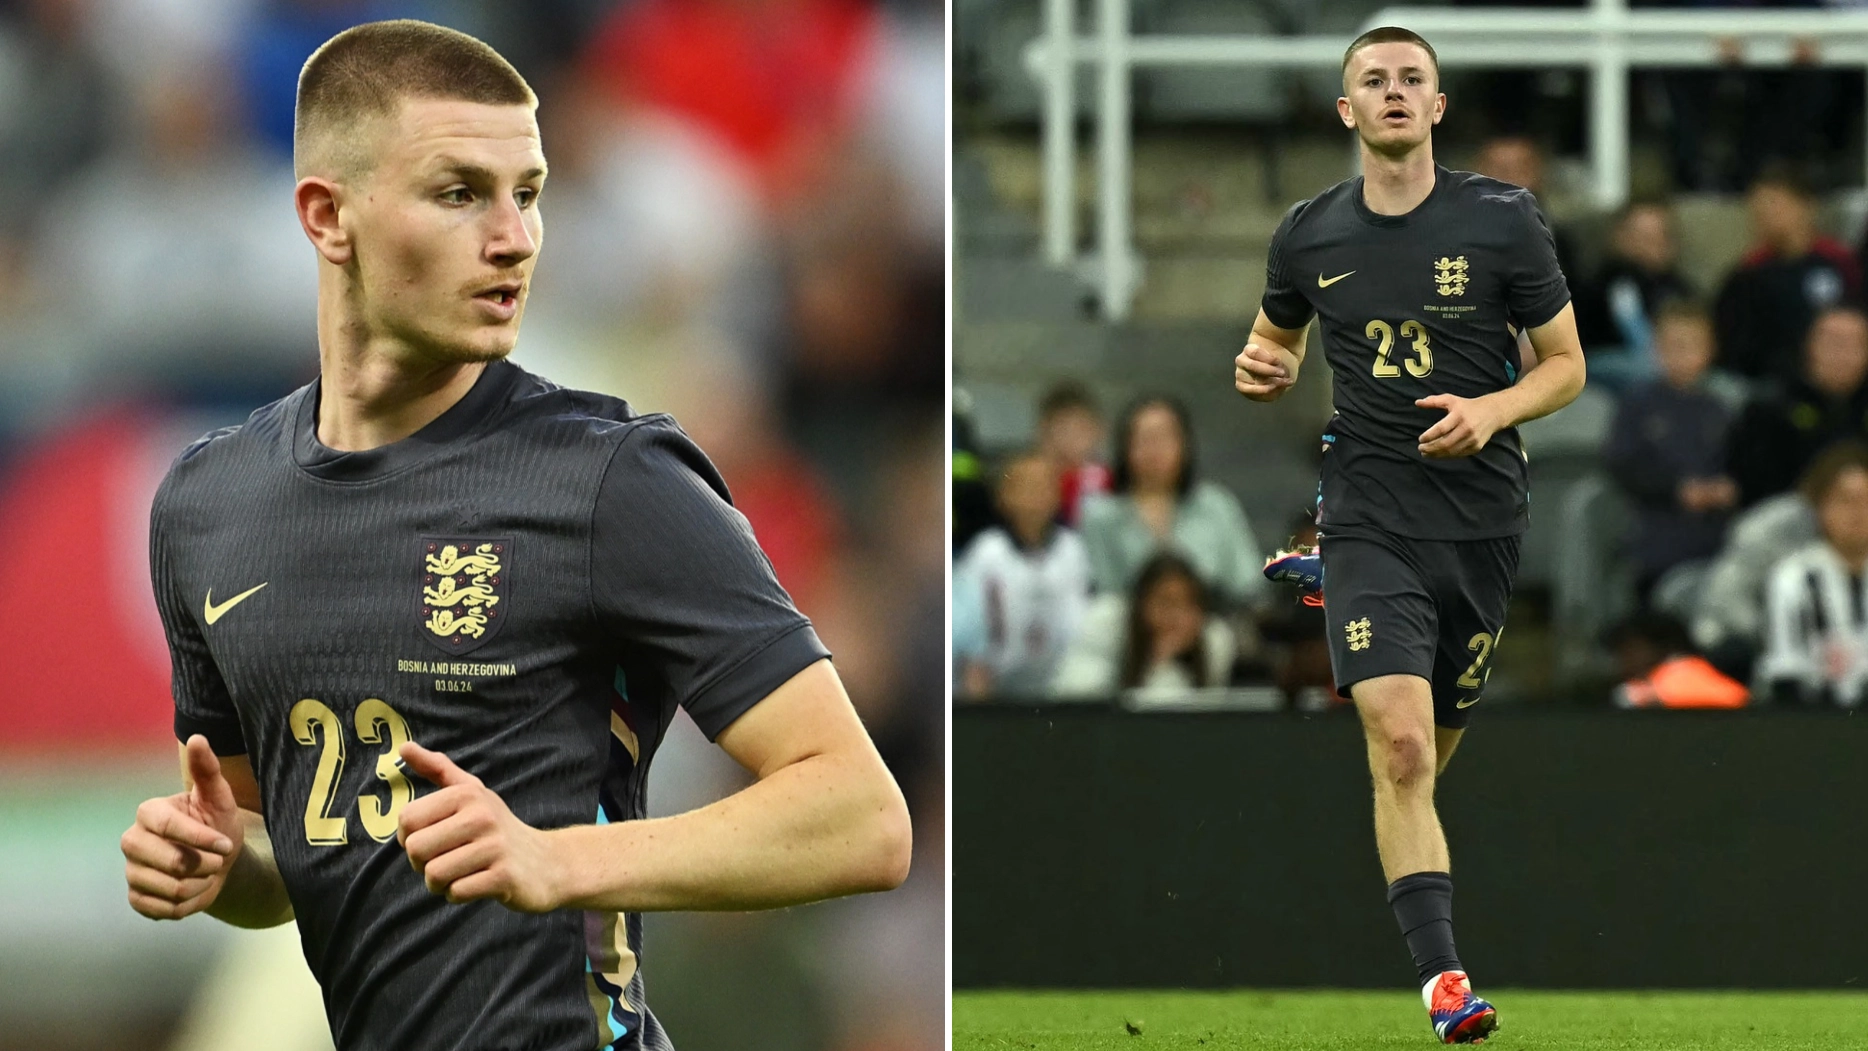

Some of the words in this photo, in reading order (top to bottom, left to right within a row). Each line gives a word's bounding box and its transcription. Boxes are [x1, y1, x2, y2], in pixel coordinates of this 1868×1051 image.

[1365, 319, 1434, 378] 23
[398, 659, 429, 674] BOSNIA
[430, 661, 449, 675] AND
[450, 662, 517, 677] HERZEGOVINA
[435, 679, 473, 692] 03.06.24
[1456, 626, 1504, 689] 2
[289, 698, 415, 846] 23
